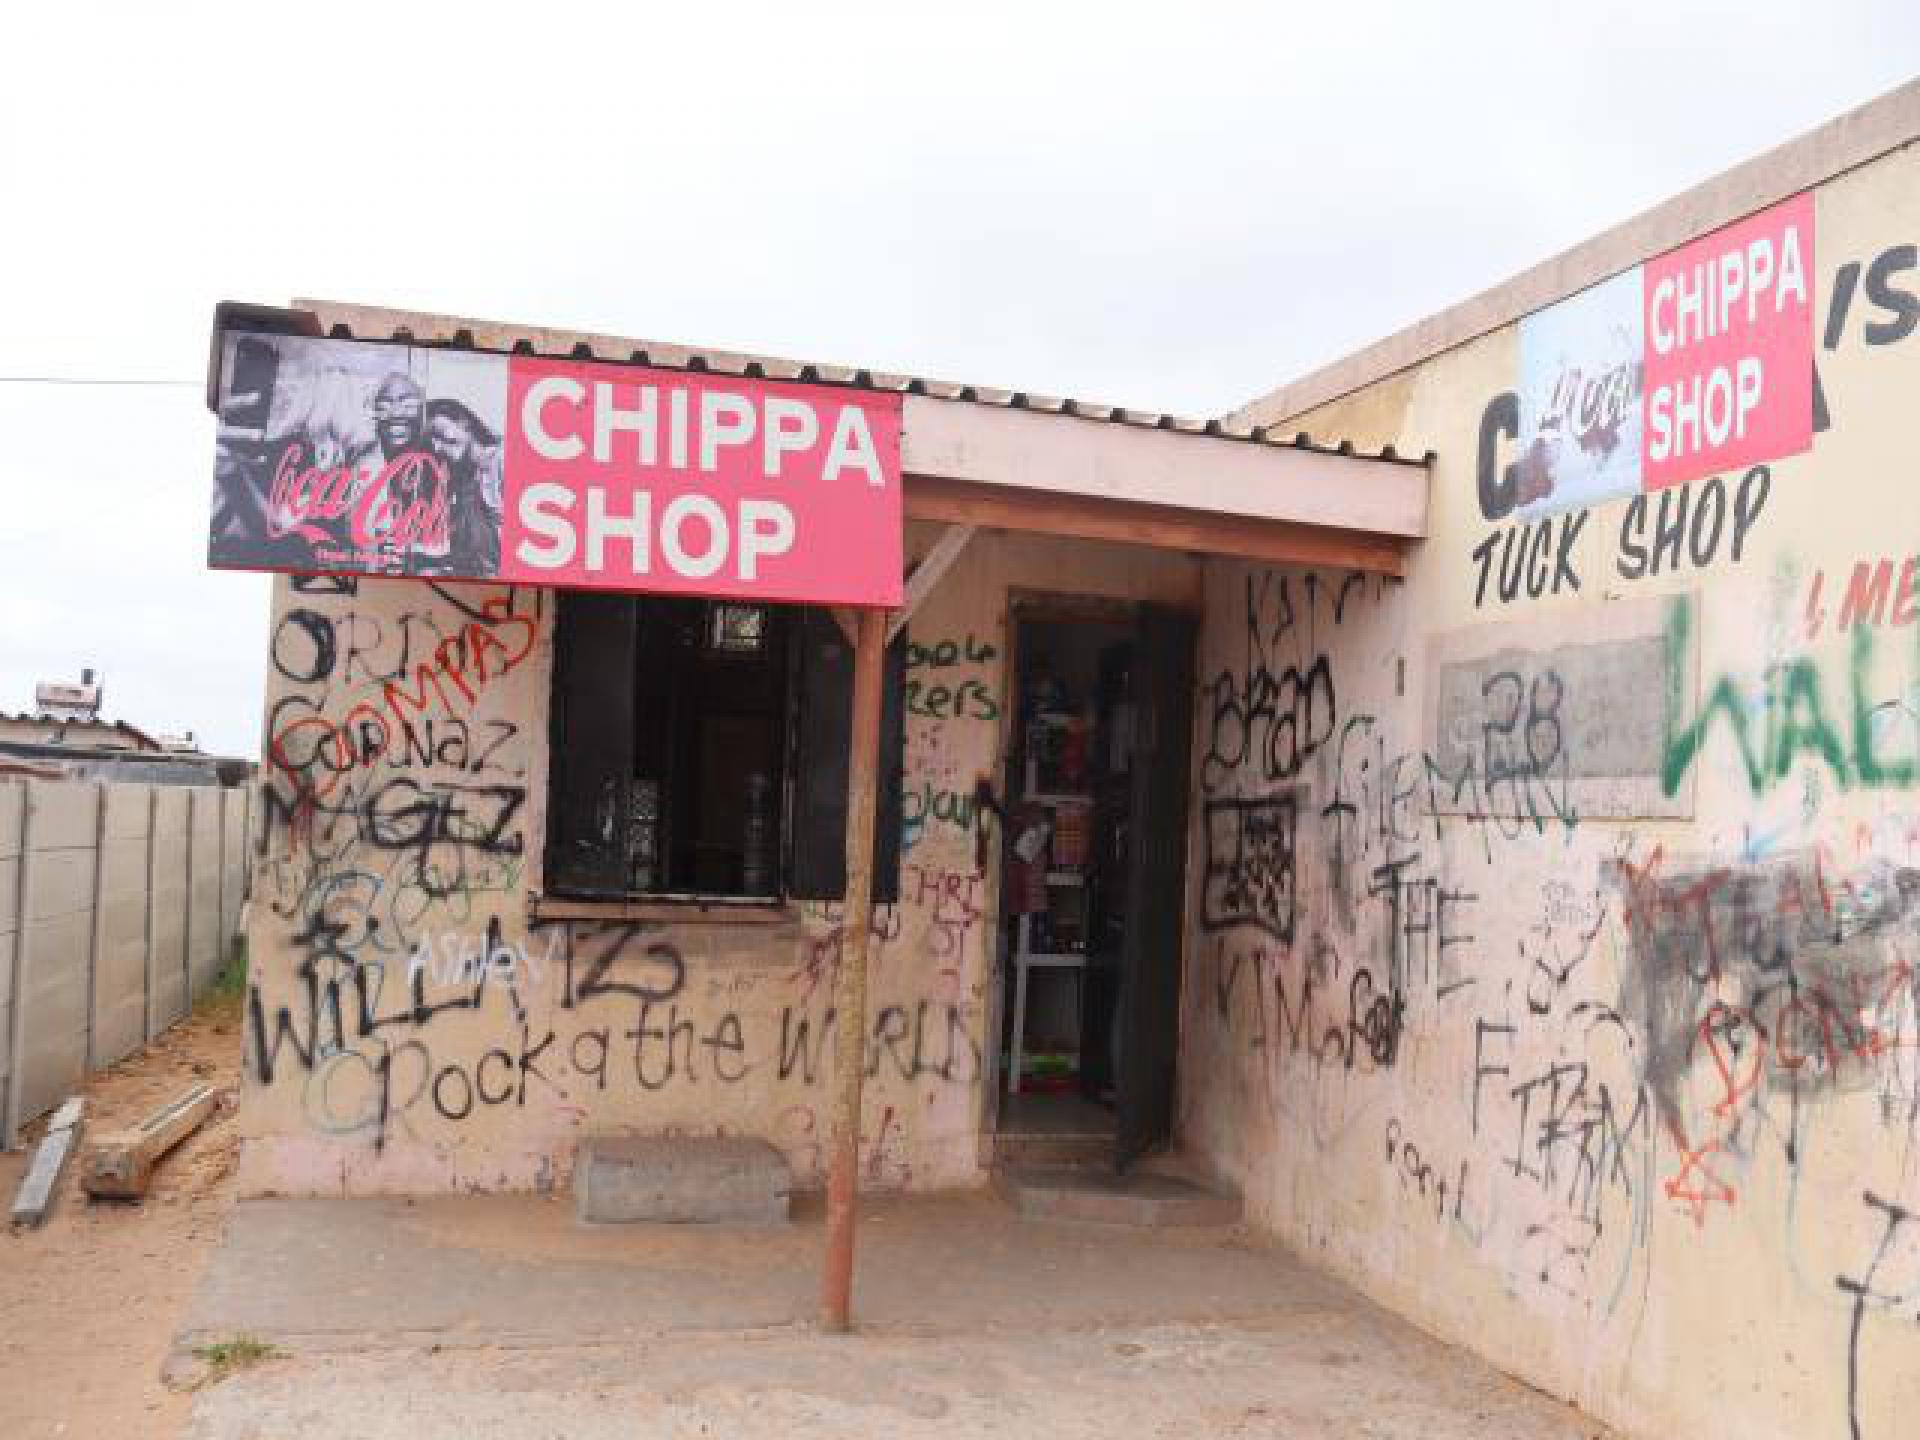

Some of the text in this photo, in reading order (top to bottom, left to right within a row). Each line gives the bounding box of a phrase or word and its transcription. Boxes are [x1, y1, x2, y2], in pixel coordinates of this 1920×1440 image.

[1650, 226, 1806, 354] CHIPPA
[521, 376, 885, 487] CHIPPA
[1649, 357, 1763, 461] SHOP
[515, 482, 797, 581] SHOP
[1472, 464, 1771, 608] TUCK SHOP
